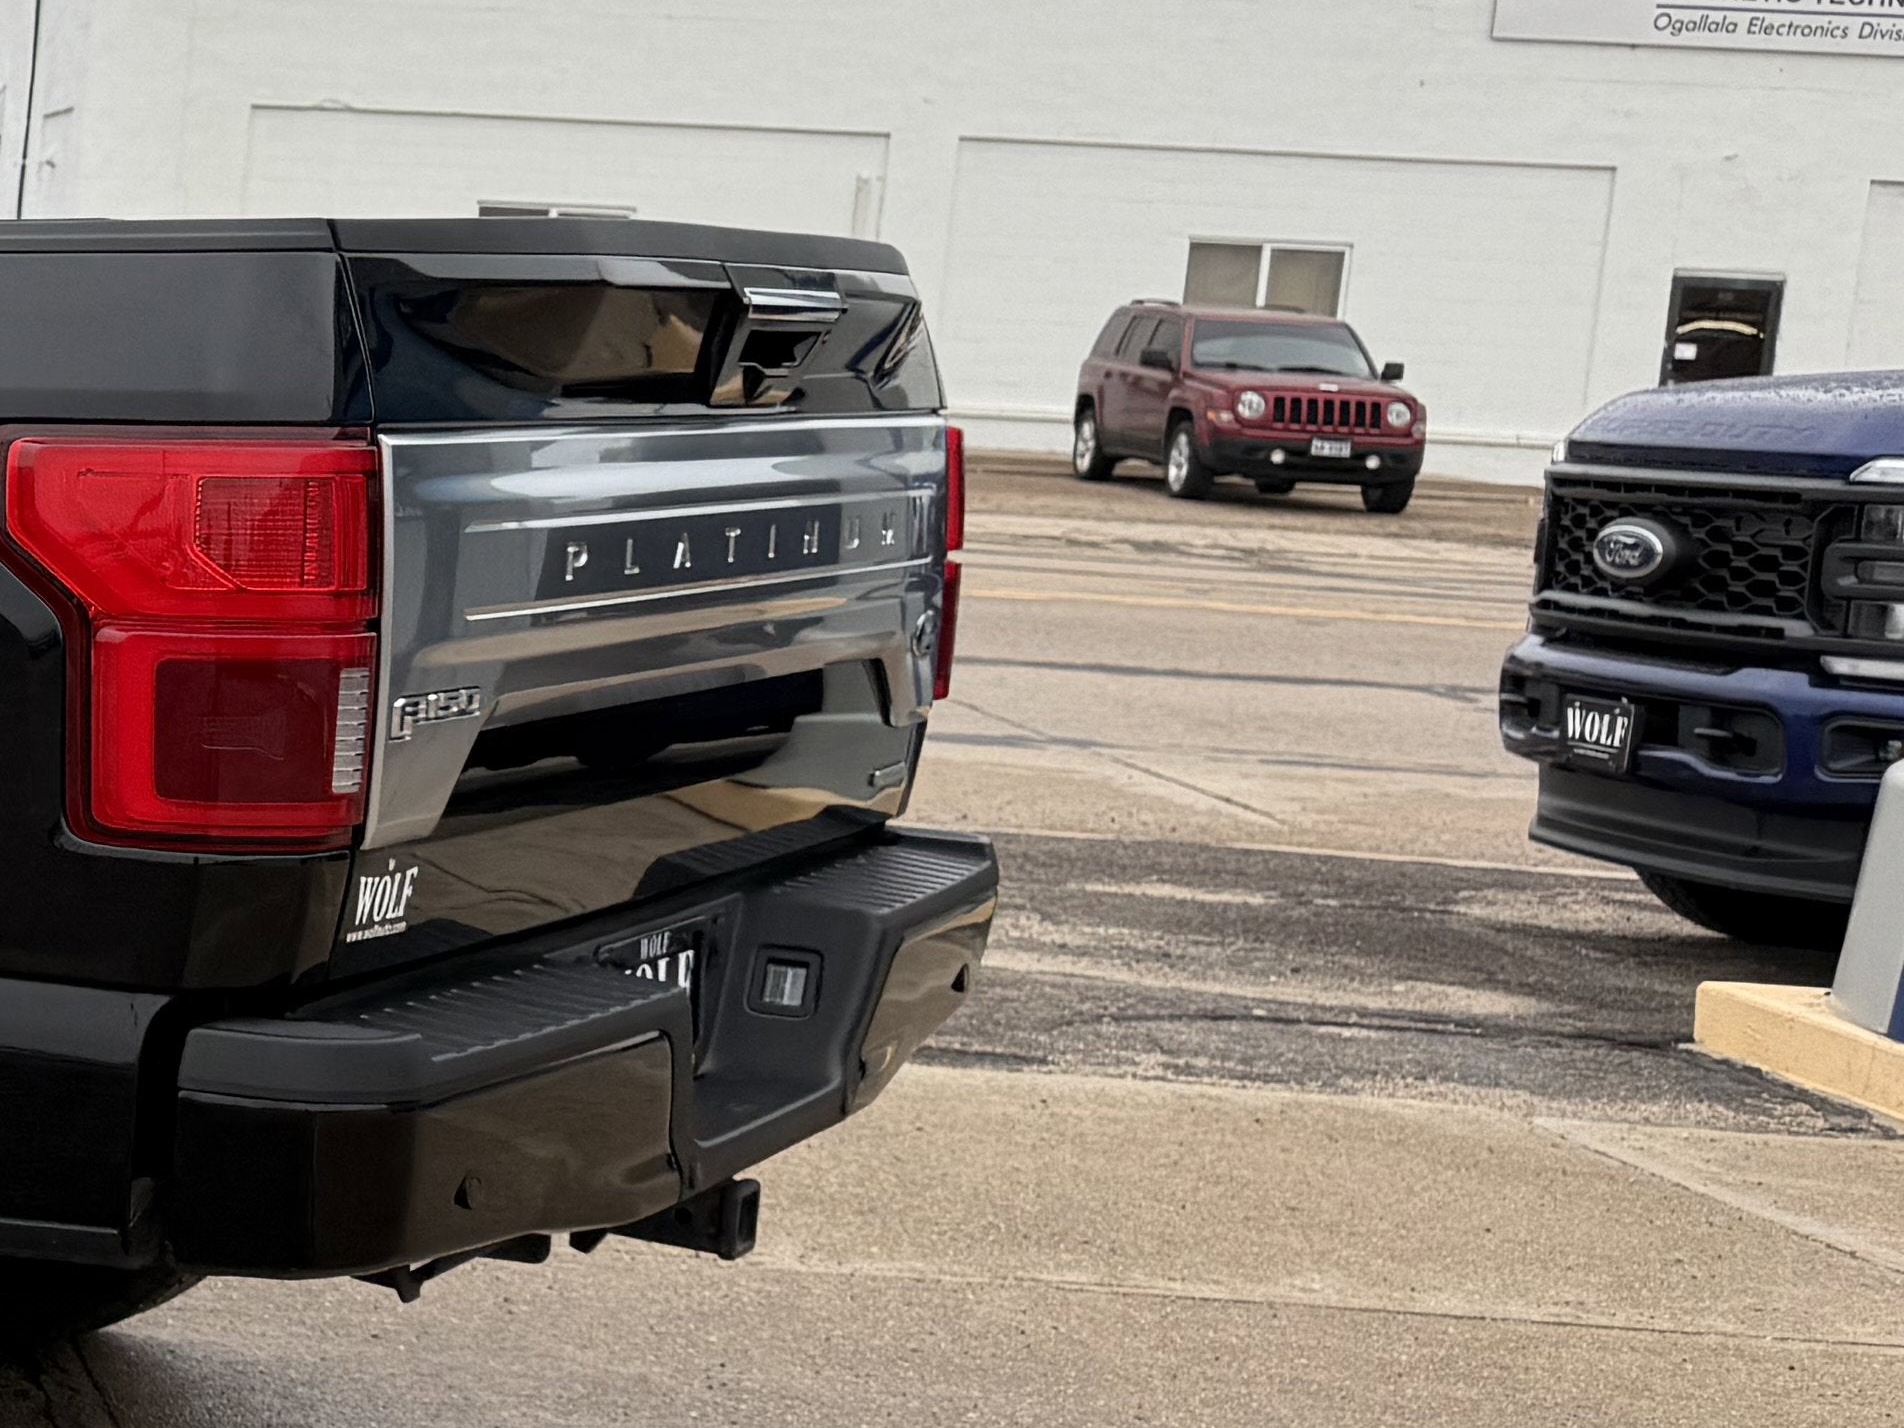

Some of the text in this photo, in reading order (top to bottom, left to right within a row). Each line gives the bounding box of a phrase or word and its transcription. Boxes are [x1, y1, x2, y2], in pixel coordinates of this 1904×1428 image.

[1653, 11, 1738, 37] Ogallala
[1746, 15, 1849, 40] Electronics
[564, 510, 897, 582] PLATINUM
[1567, 706, 1629, 748] WOLF
[355, 865, 419, 926] WOLF
